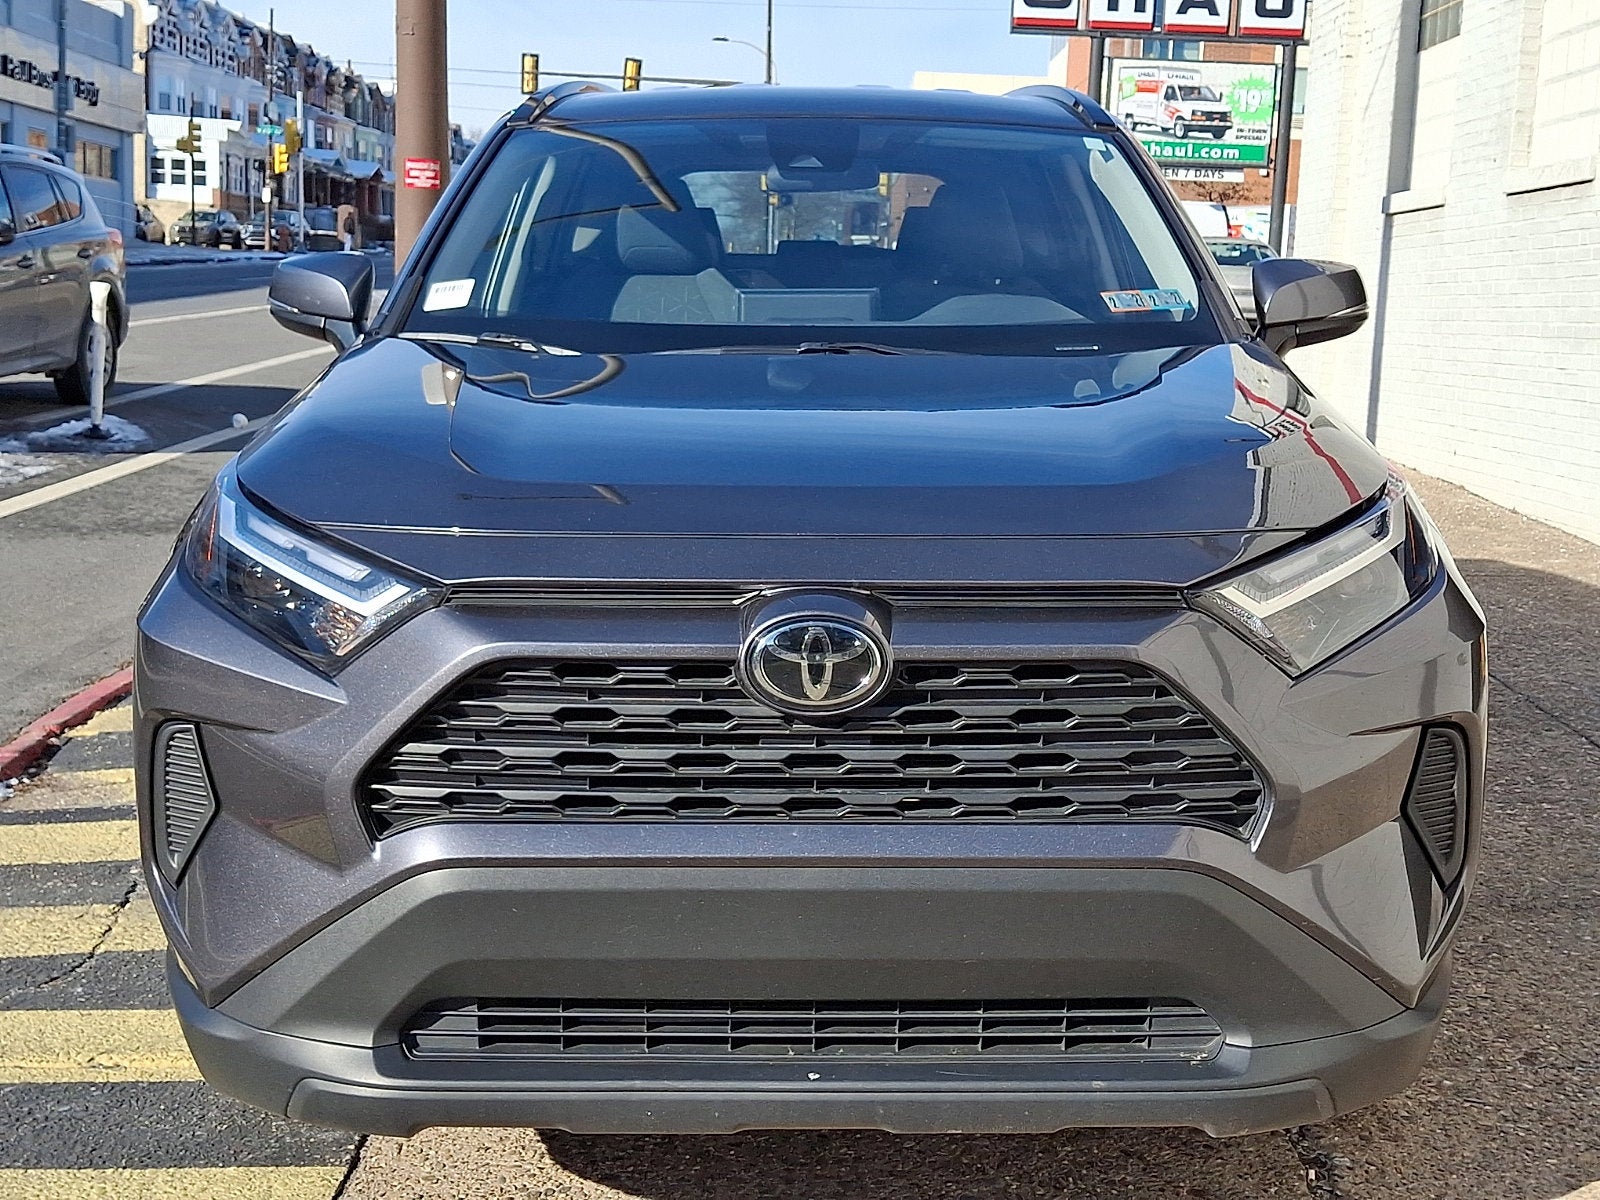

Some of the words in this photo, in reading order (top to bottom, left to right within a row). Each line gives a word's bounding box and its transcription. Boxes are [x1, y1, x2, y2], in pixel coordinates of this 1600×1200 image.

[1162, 168, 1179, 178] EN
[1184, 168, 1192, 178] 7
[1194, 168, 1224, 179] DAYS
